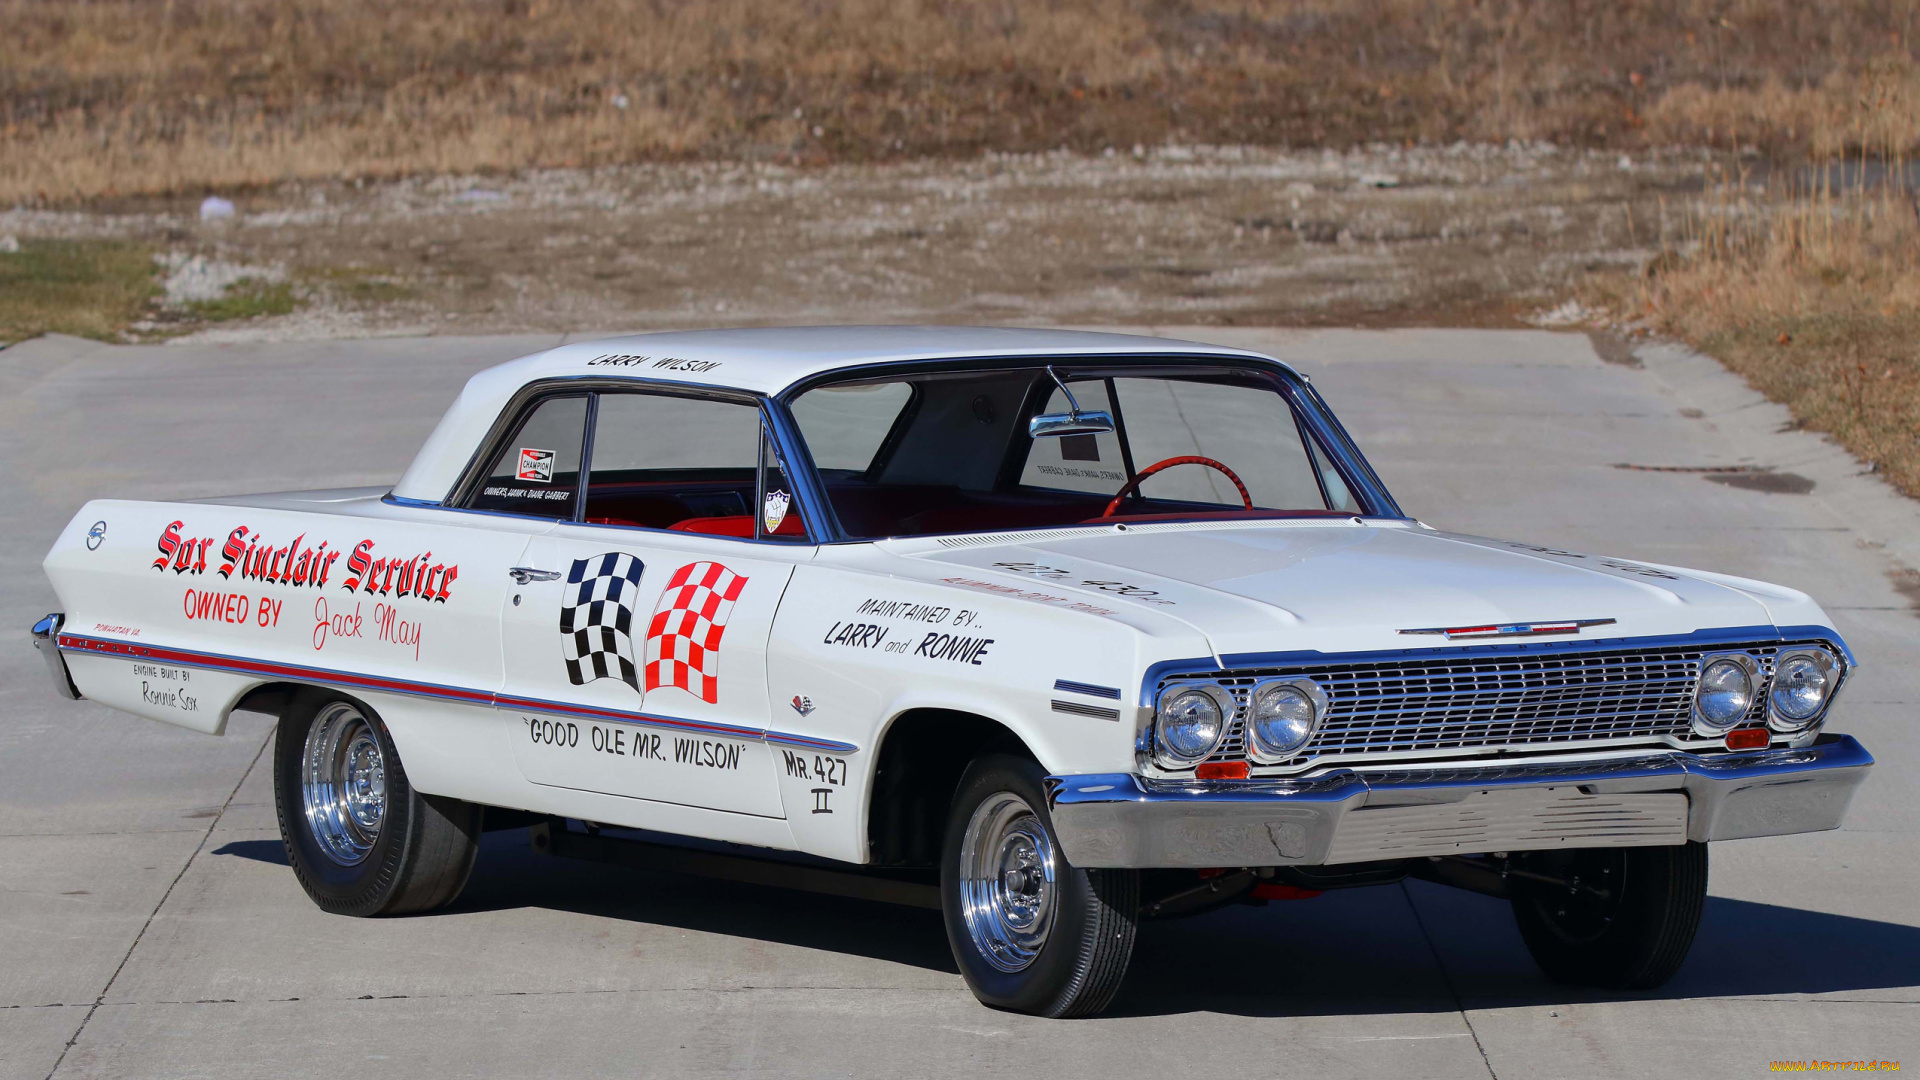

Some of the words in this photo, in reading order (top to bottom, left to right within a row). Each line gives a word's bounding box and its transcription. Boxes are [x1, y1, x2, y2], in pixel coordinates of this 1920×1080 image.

[587, 354, 651, 367] LARRY
[652, 357, 722, 373] WILSON
[523, 460, 550, 471] CHAMPION
[151, 520, 215, 576] Sox
[217, 525, 340, 590] Sinclair
[341, 539, 458, 604] Service
[184, 588, 249, 624] OWNED
[257, 597, 282, 628] BY
[313, 597, 362, 650] Jack
[374, 603, 422, 661] May
[856, 598, 950, 624] MAINTAINED
[94, 623, 131, 636] POWHATAN
[824, 621, 889, 649] LARRY
[884, 639, 912, 654] and
[914, 632, 995, 665] RONNIE
[133, 664, 158, 678] ENGINE
[161, 667, 178, 680] BUILT
[182, 671, 190, 682] BY
[142, 681, 176, 708] Ronnie
[178, 688, 198, 712] Sox
[592, 726, 625, 756] OLE
[632, 732, 666, 762] MR.
[781, 750, 812, 780] MR.
[814, 755, 847, 786] 427
[811, 788, 833, 814] II
